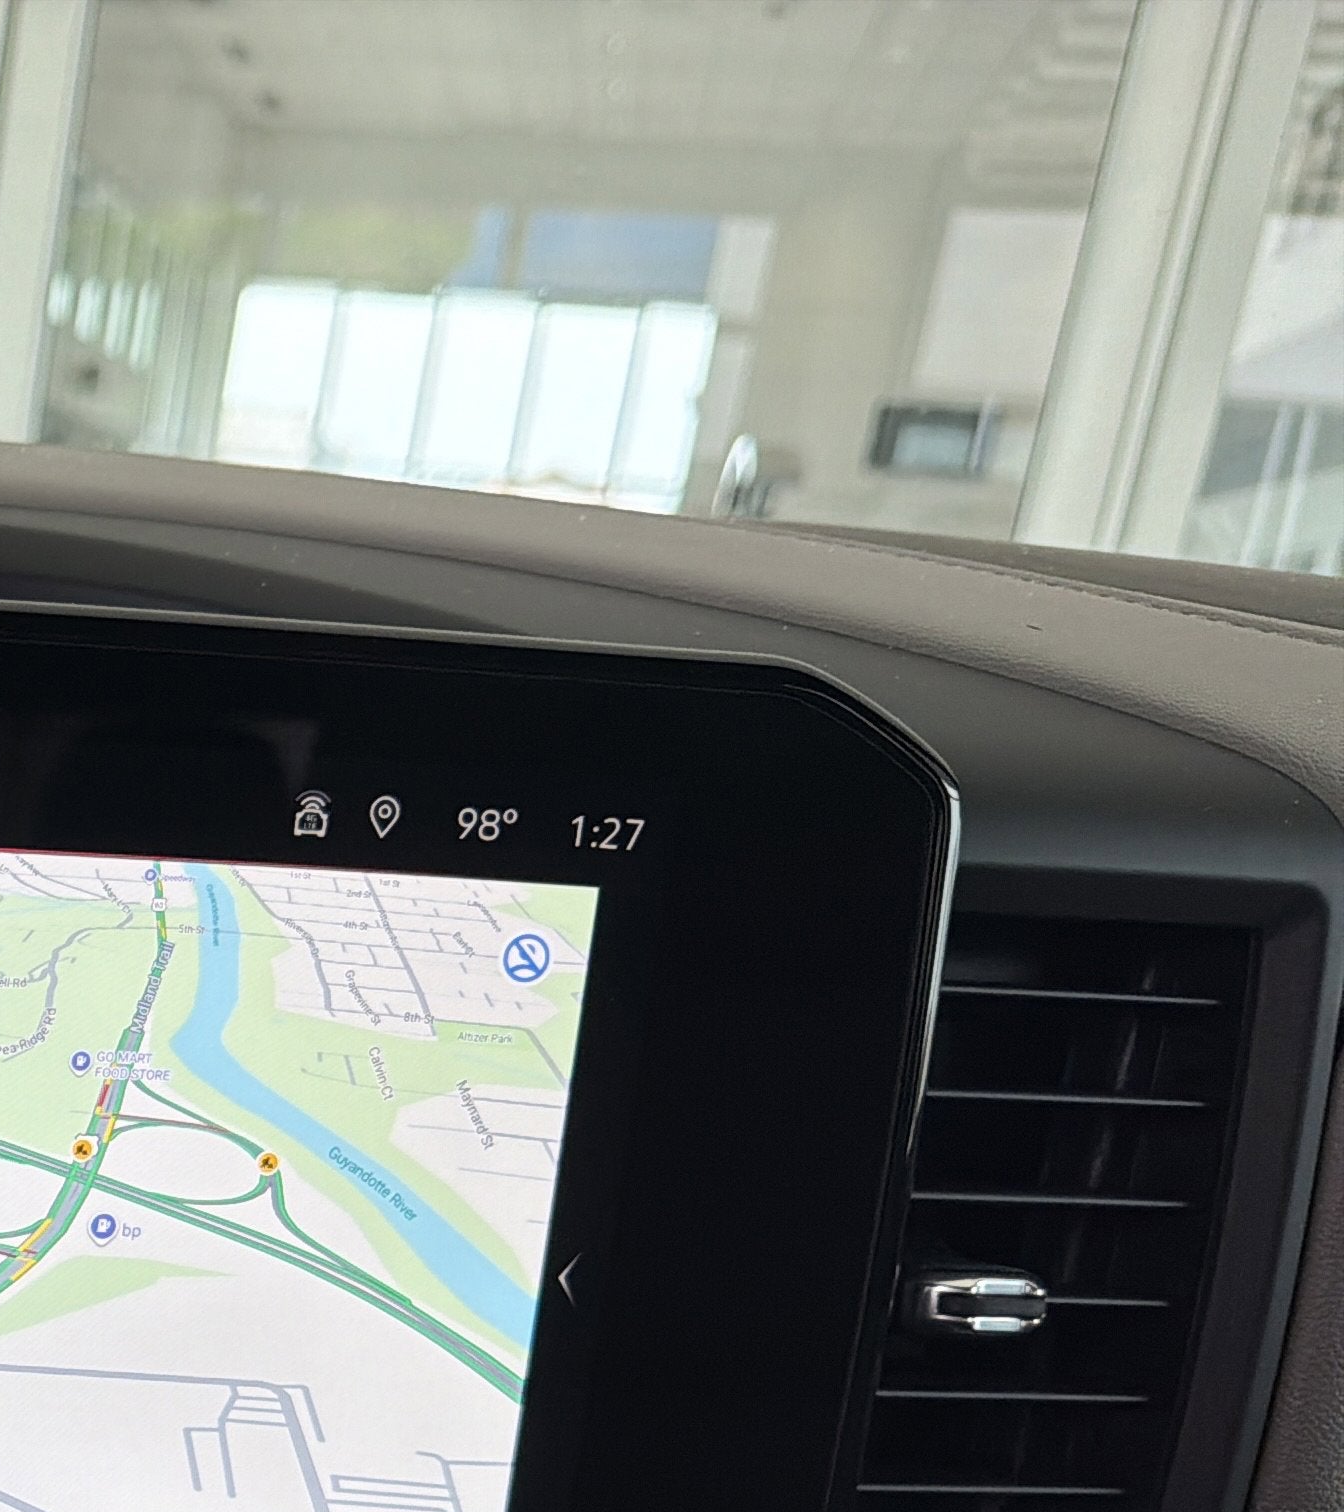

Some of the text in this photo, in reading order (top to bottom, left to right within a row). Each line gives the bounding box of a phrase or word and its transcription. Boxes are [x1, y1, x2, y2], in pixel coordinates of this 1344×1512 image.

[570, 815, 646, 850] 1:27
[178, 924, 194, 934] 5th
[12, 977, 28, 988] Rd
[131, 941, 176, 1033] Midland Trail
[345, 970, 382, 1026] Grapevine St
[18, 1024, 49, 1050] Ridge
[45, 1007, 56, 1026] Rd
[404, 1012, 434, 1024] 8th St
[458, 1032, 513, 1044] Altizer Park
[96, 1051, 152, 1064] GO MART
[95, 1067, 170, 1081] FOOD STORE
[368, 1046, 394, 1100] Calvin Ct
[456, 1080, 494, 1150] Maynard St
[328, 1146, 418, 1221] Guyandotte River
[122, 1224, 142, 1240] bp
